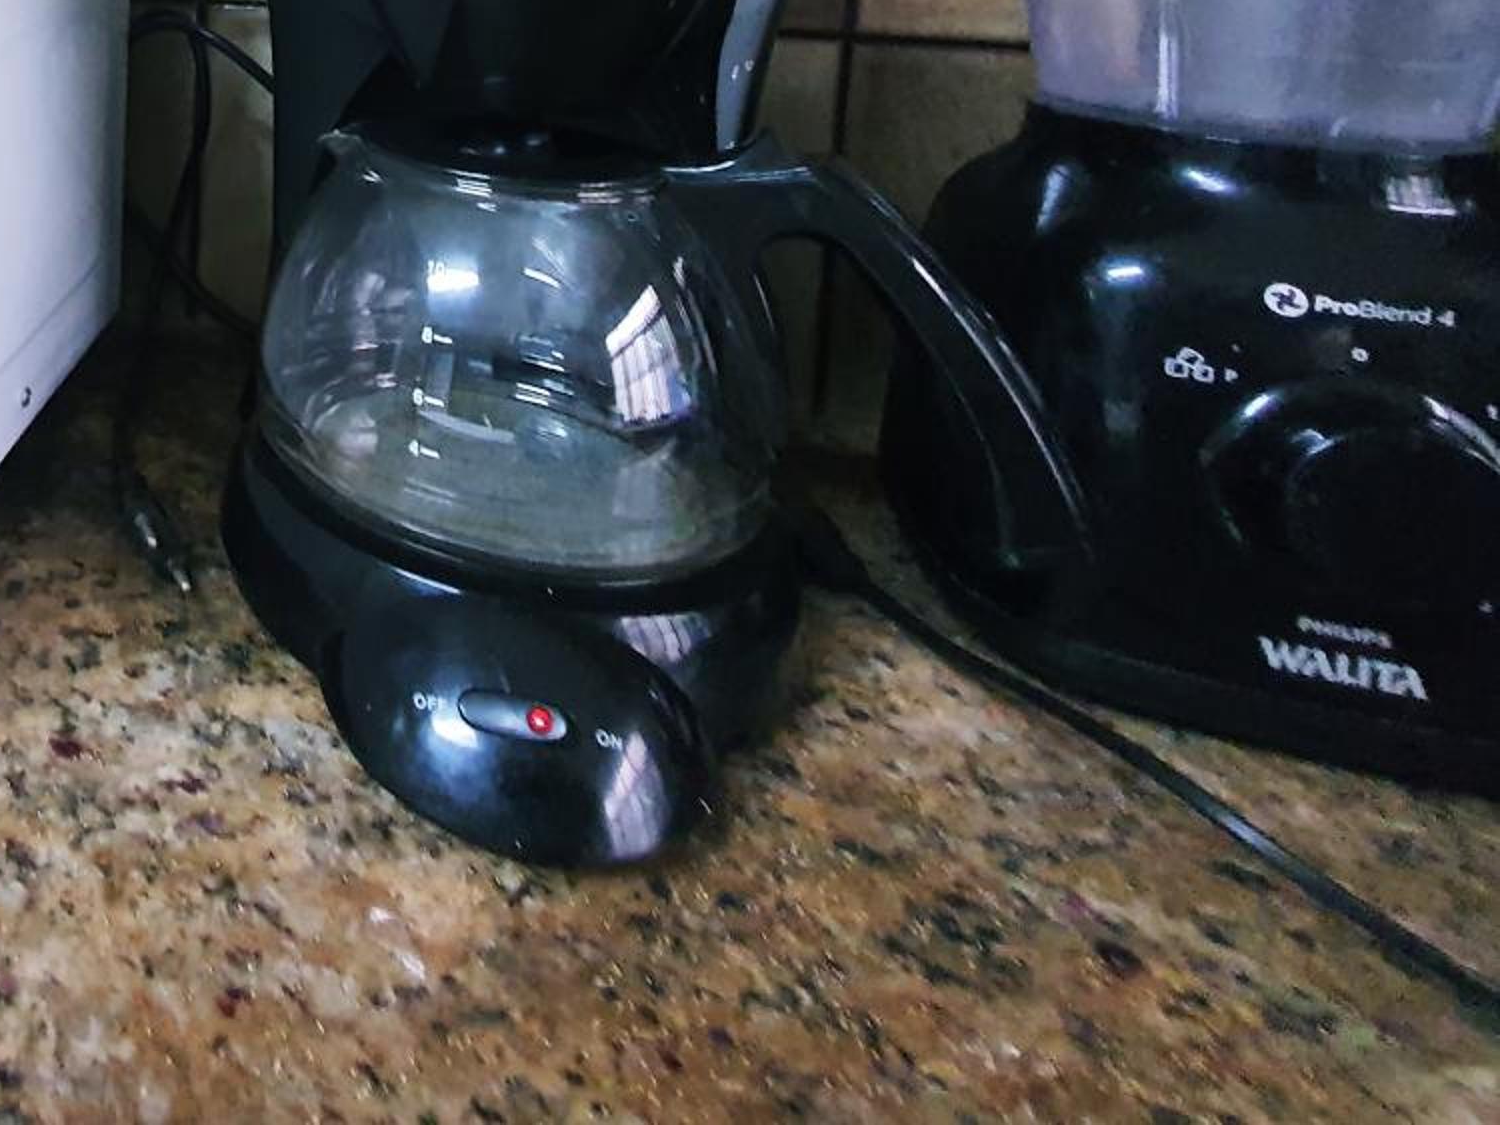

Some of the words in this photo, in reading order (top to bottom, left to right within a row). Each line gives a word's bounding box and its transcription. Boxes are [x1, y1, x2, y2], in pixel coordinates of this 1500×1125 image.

[1313, 293, 1432, 326] ProBlend
[1436, 309, 1455, 327] 4
[421, 326, 433, 344] 8
[413, 387, 424, 406] 6
[408, 438, 419, 458] 4
[1257, 635, 1429, 701] WALITA
[412, 691, 444, 711] OFF
[595, 729, 623, 750] ON
